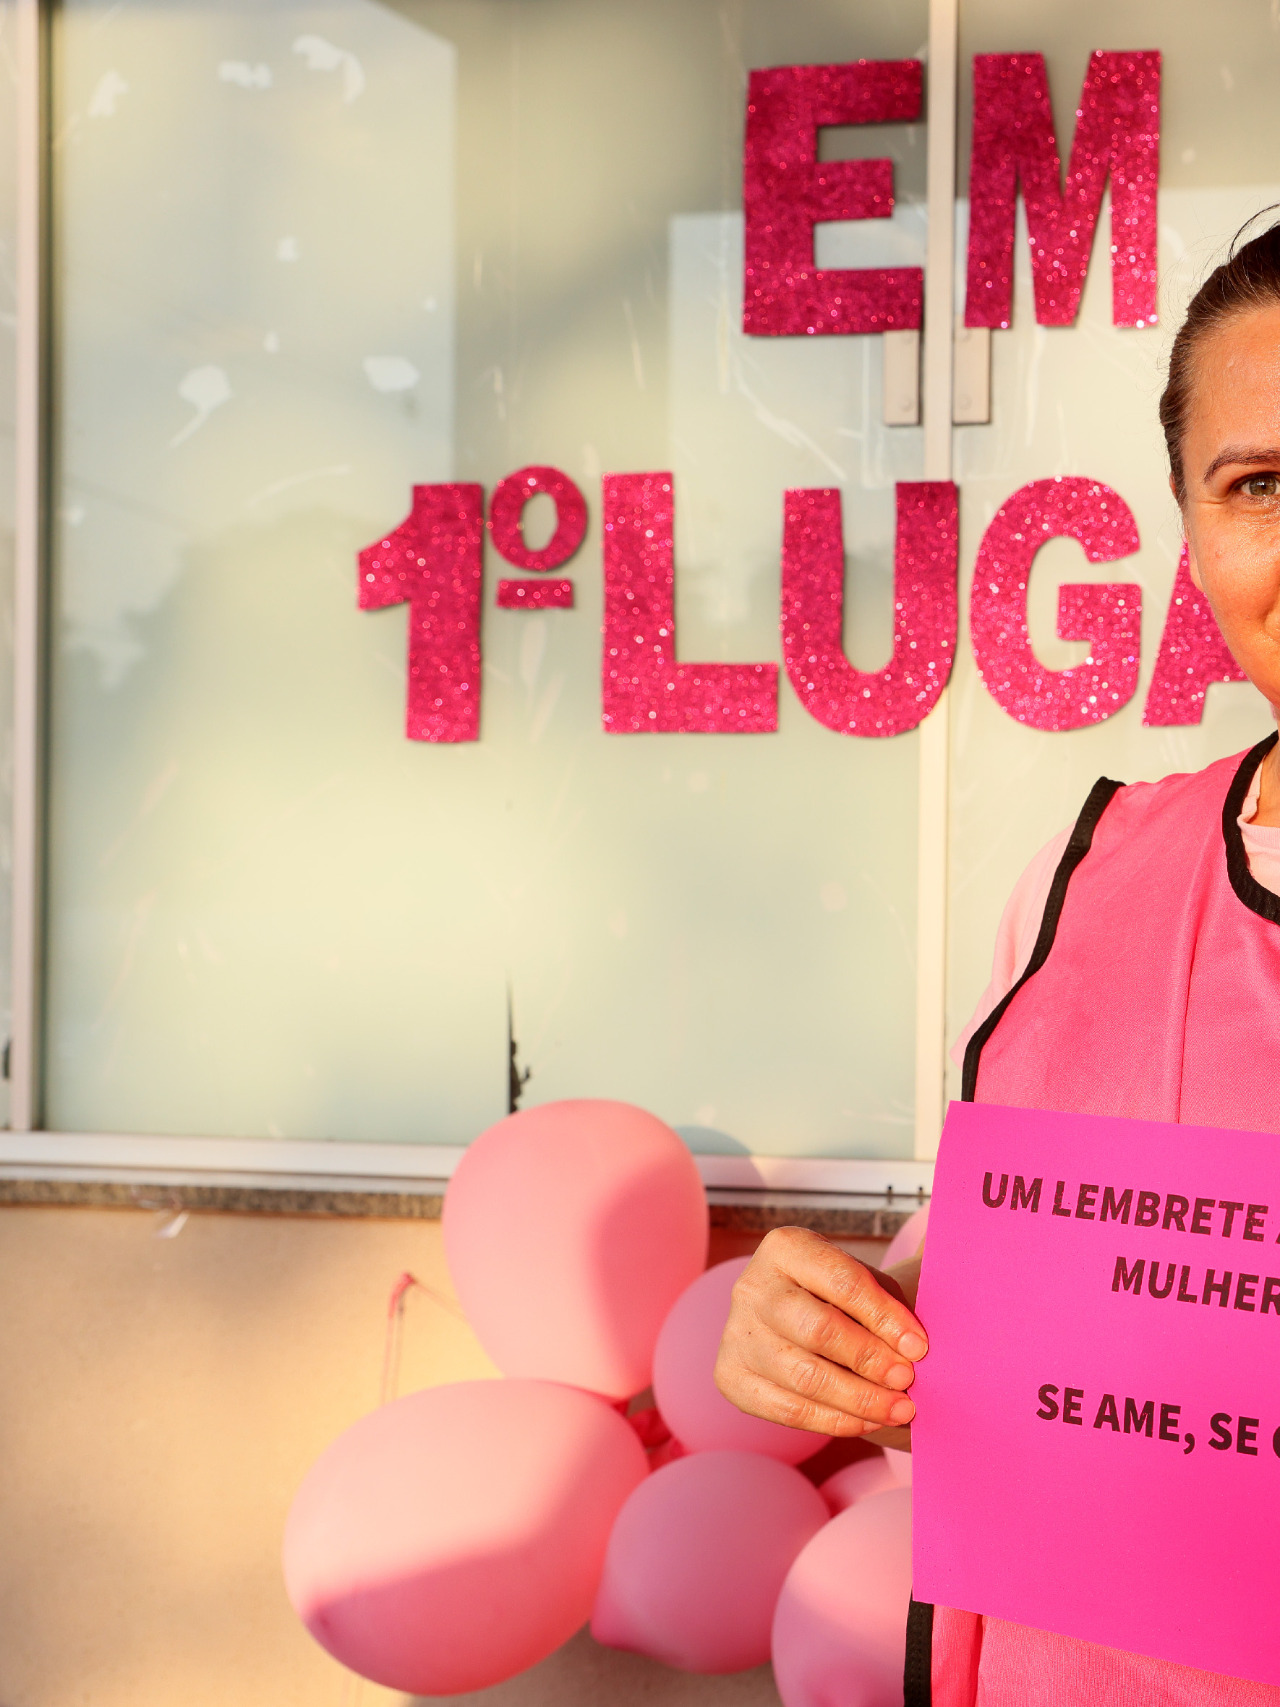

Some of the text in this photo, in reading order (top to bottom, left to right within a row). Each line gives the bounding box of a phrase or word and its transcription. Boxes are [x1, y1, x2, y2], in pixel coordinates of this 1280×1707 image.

[743, 48, 1162, 338] EM
[982, 1171, 1042, 1213] UM
[1052, 1180, 1269, 1242] LEMBRETE
[1036, 1383, 1084, 1426] SE
[1094, 1393, 1195, 1455] AME,
[1208, 1412, 1260, 1457] SE
